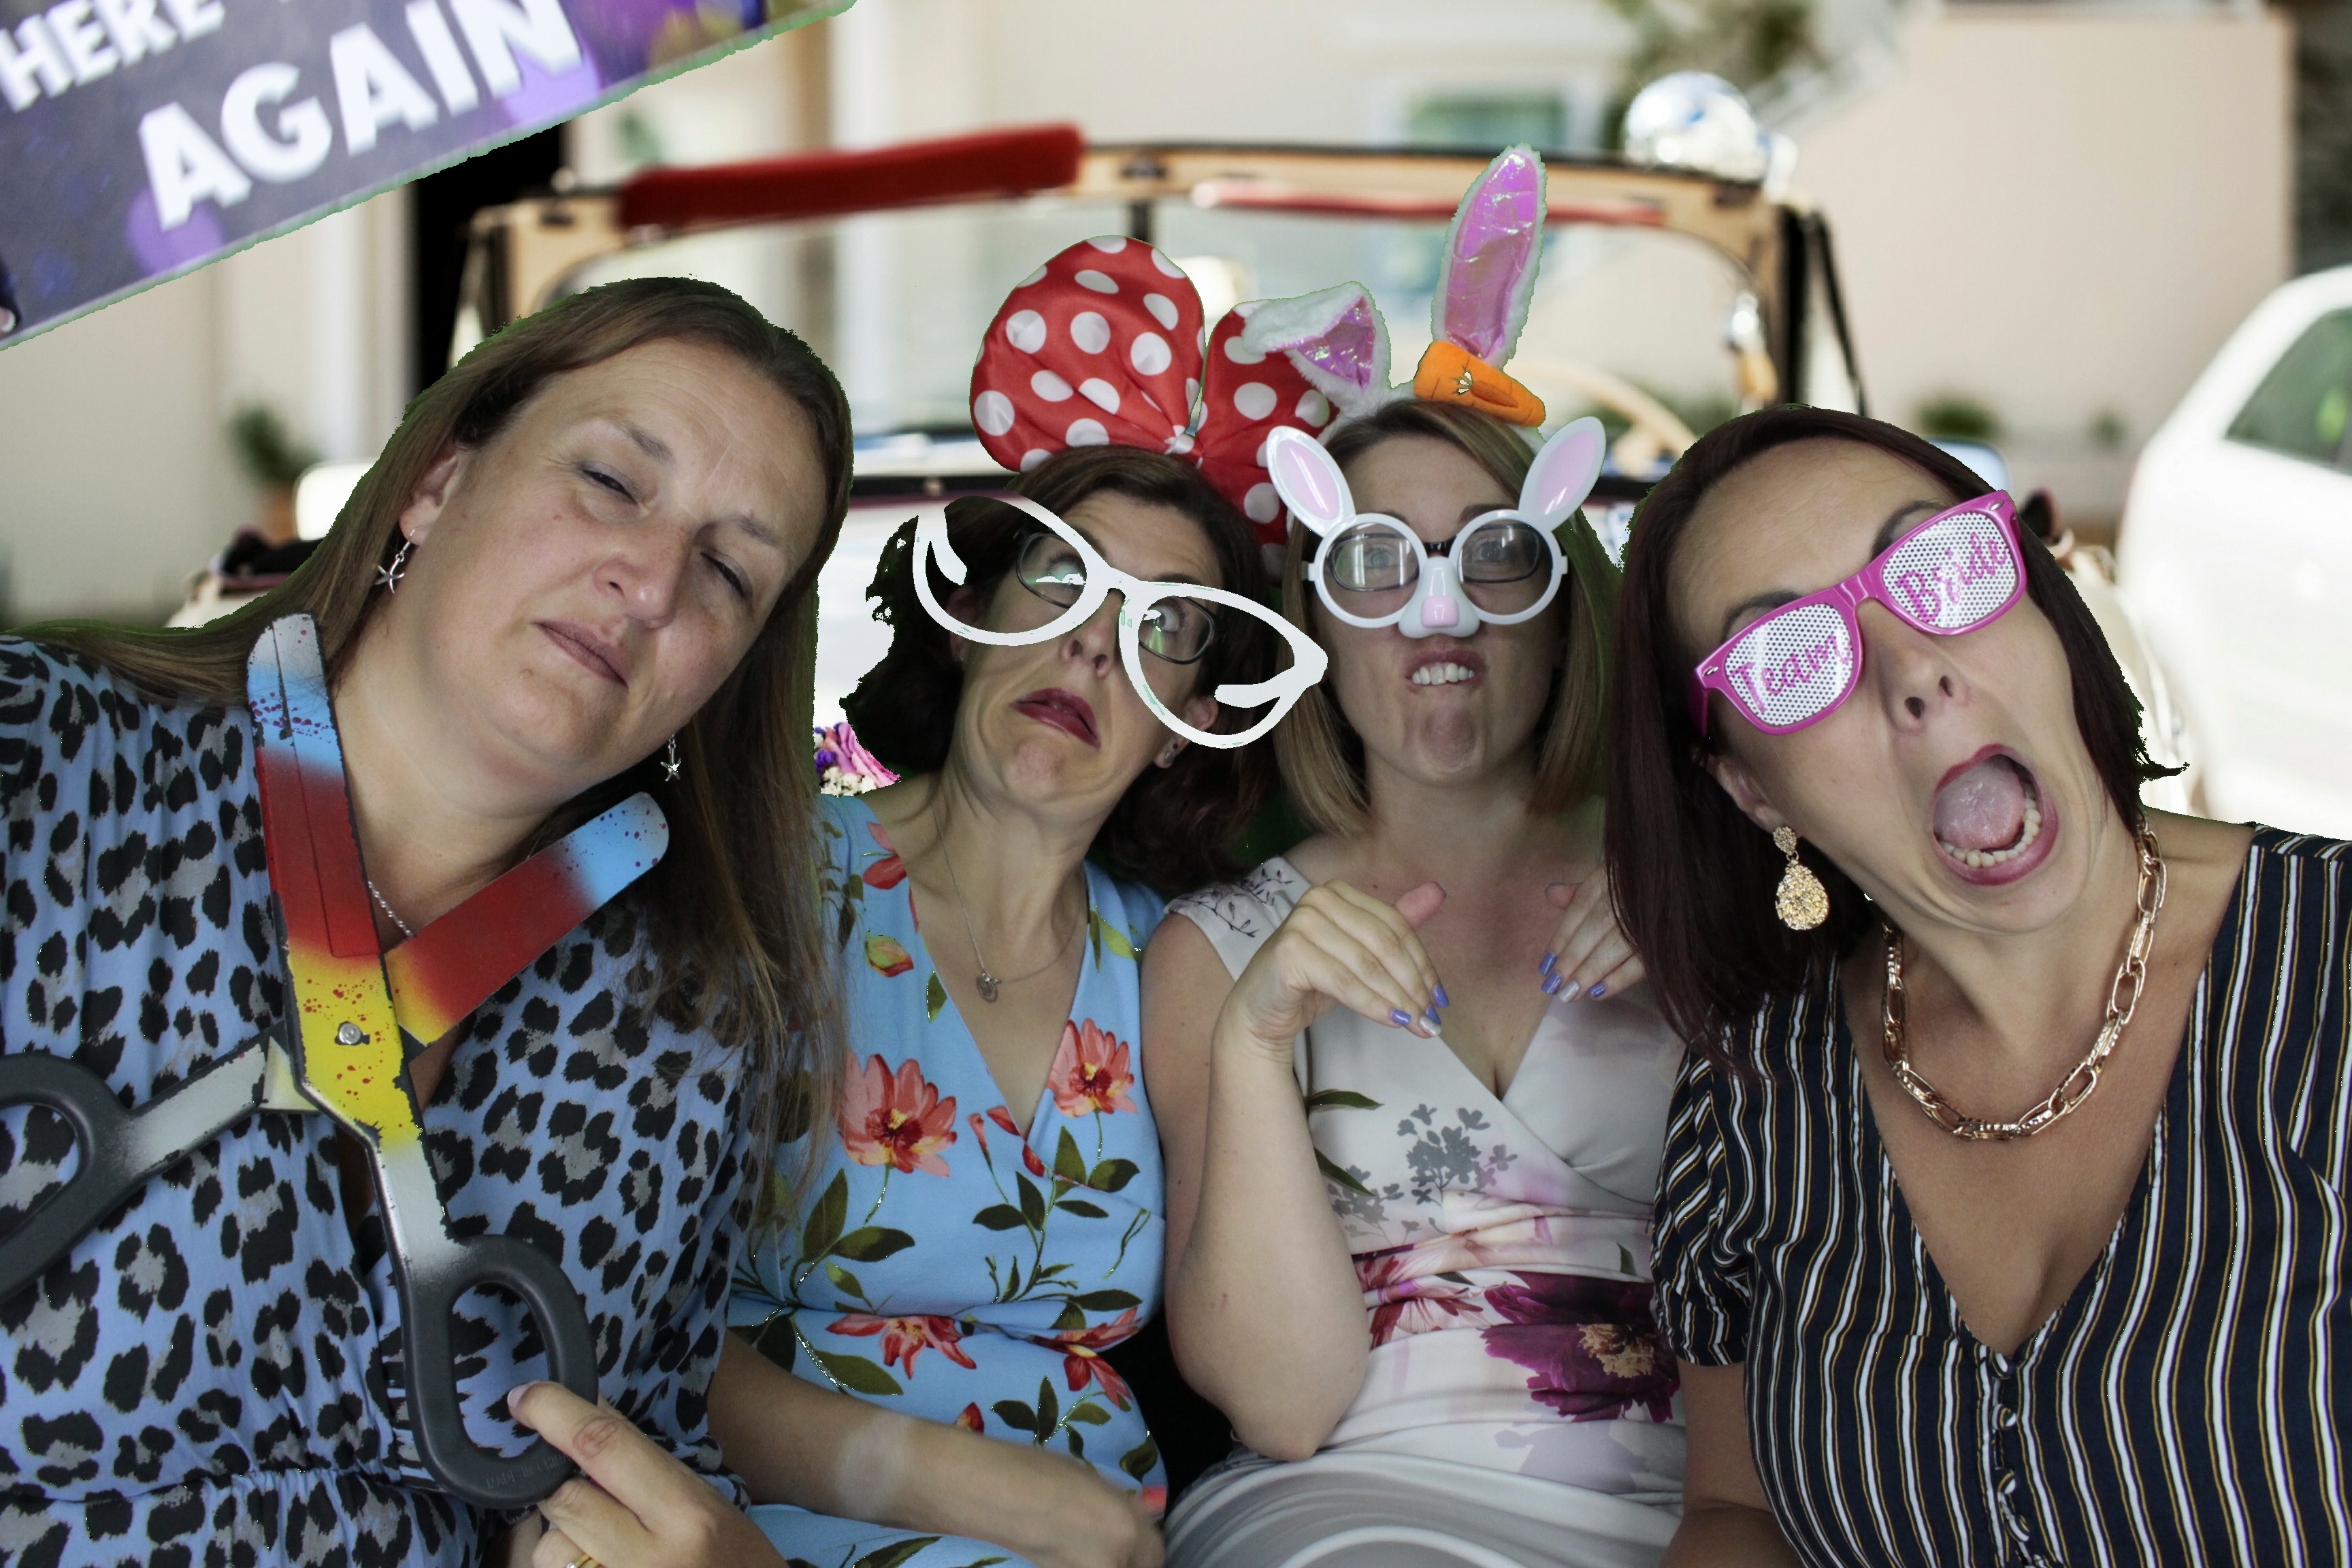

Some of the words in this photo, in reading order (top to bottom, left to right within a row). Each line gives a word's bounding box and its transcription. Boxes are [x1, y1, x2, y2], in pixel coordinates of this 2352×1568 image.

[138, 0, 583, 232] AGAIN
[1730, 634, 1852, 714] Team
[1896, 532, 2009, 623] Bride
